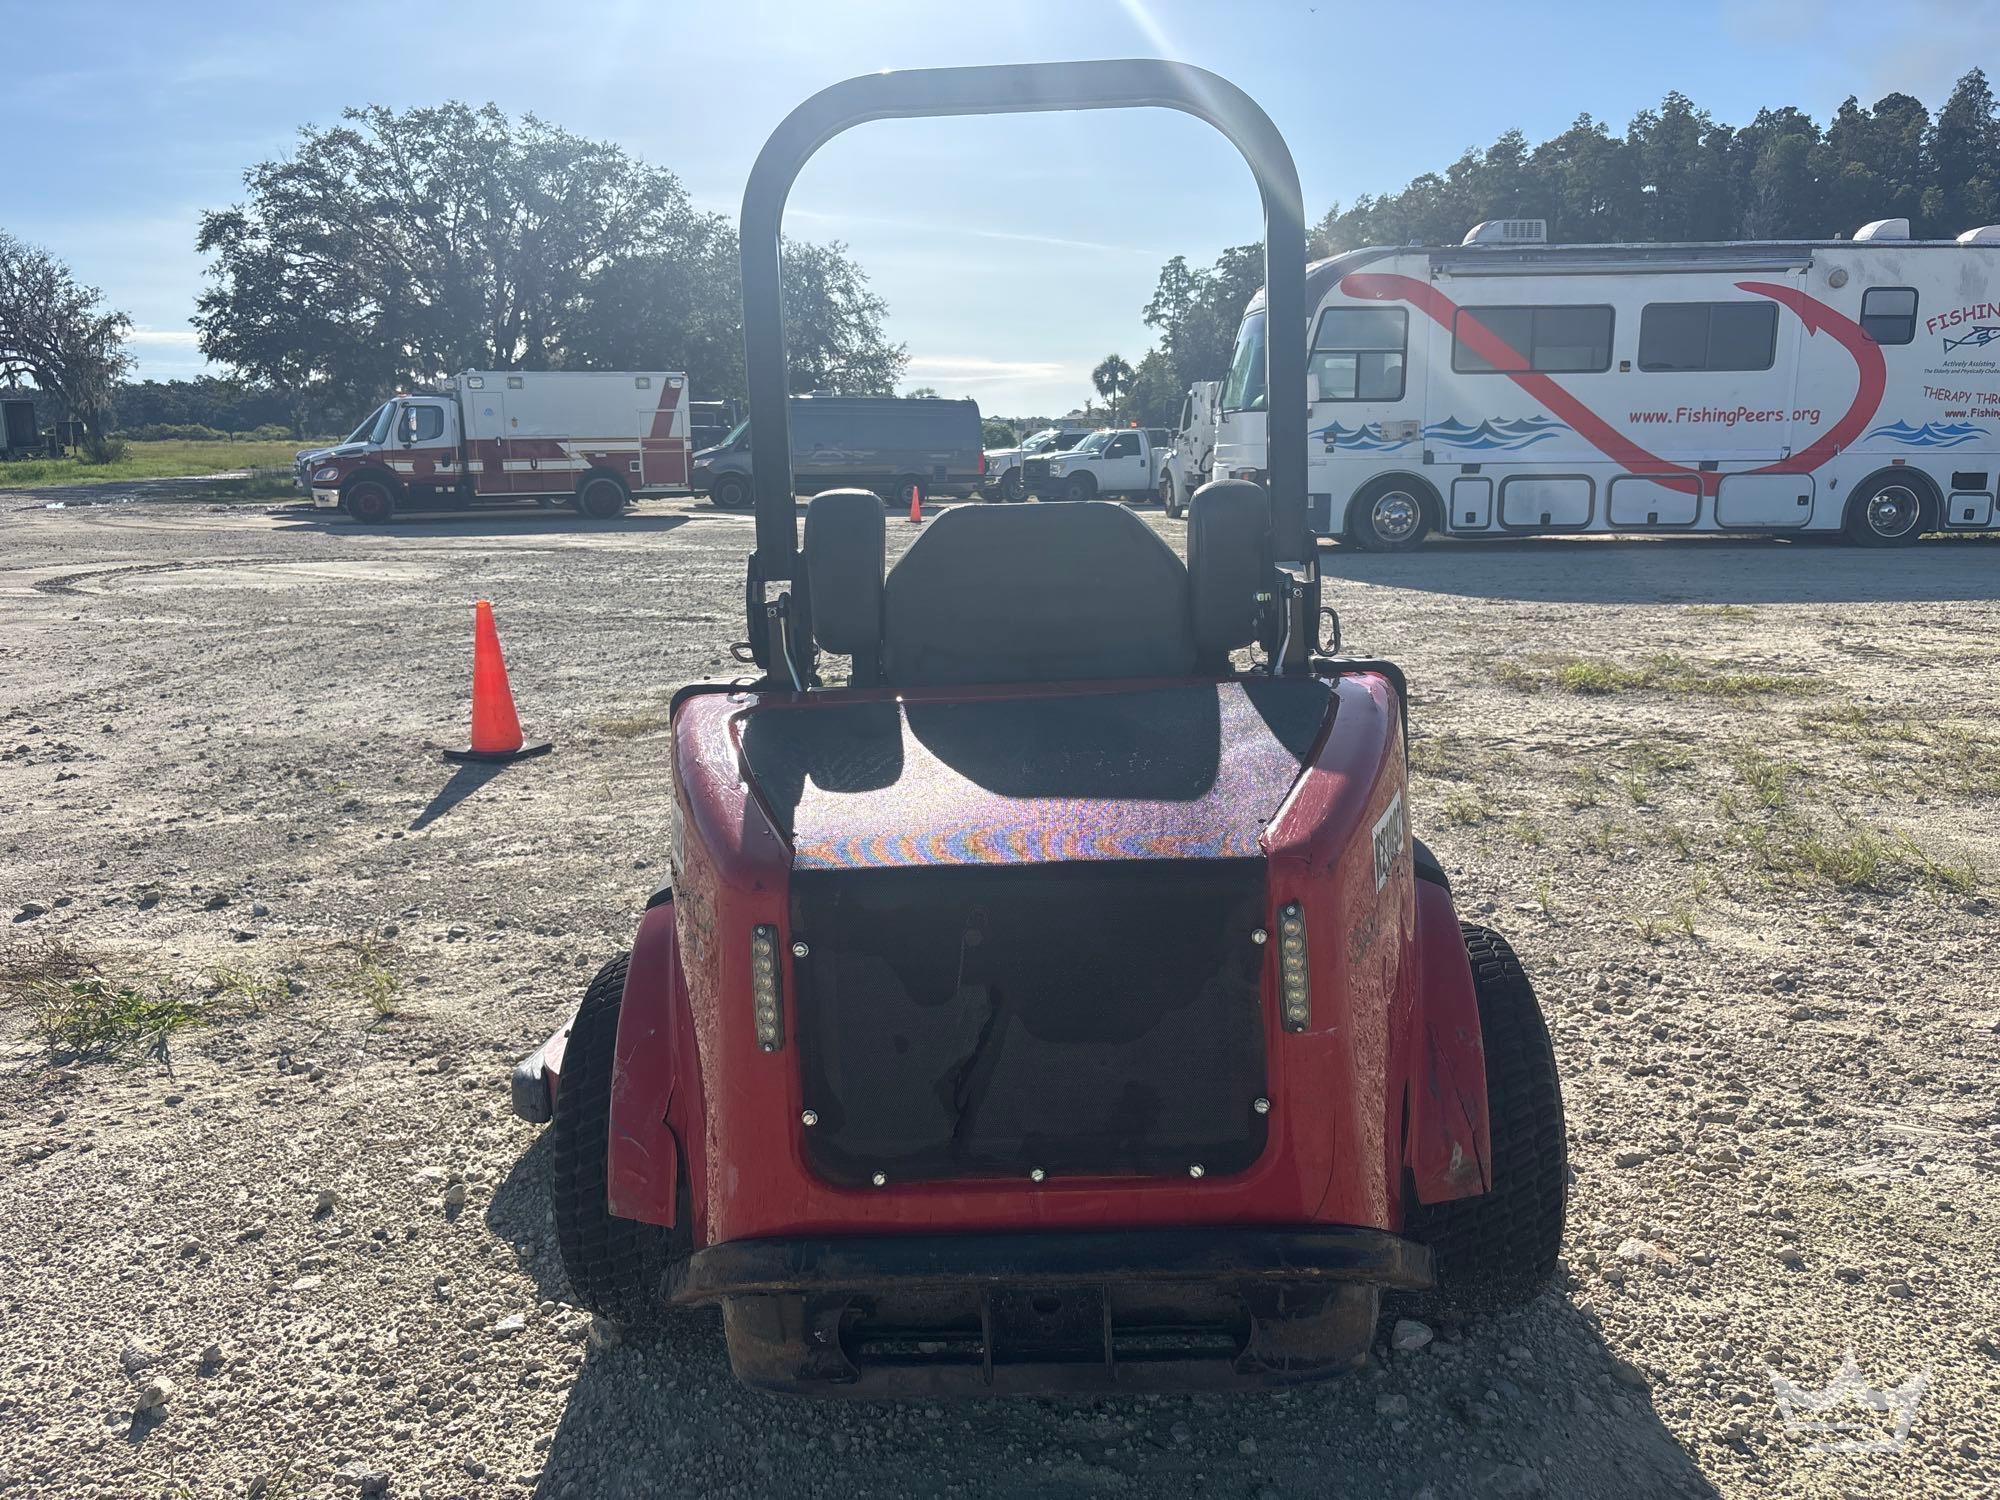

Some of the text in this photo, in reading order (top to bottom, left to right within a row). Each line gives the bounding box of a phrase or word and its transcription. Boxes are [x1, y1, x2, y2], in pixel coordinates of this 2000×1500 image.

[1926, 302, 2000, 335] FISHIN
[1942, 361, 1996, 370] Actively Assisting
[1923, 385, 2000, 405] THERAPY THR
[1629, 406, 1821, 426] www.FishingPeers.org
